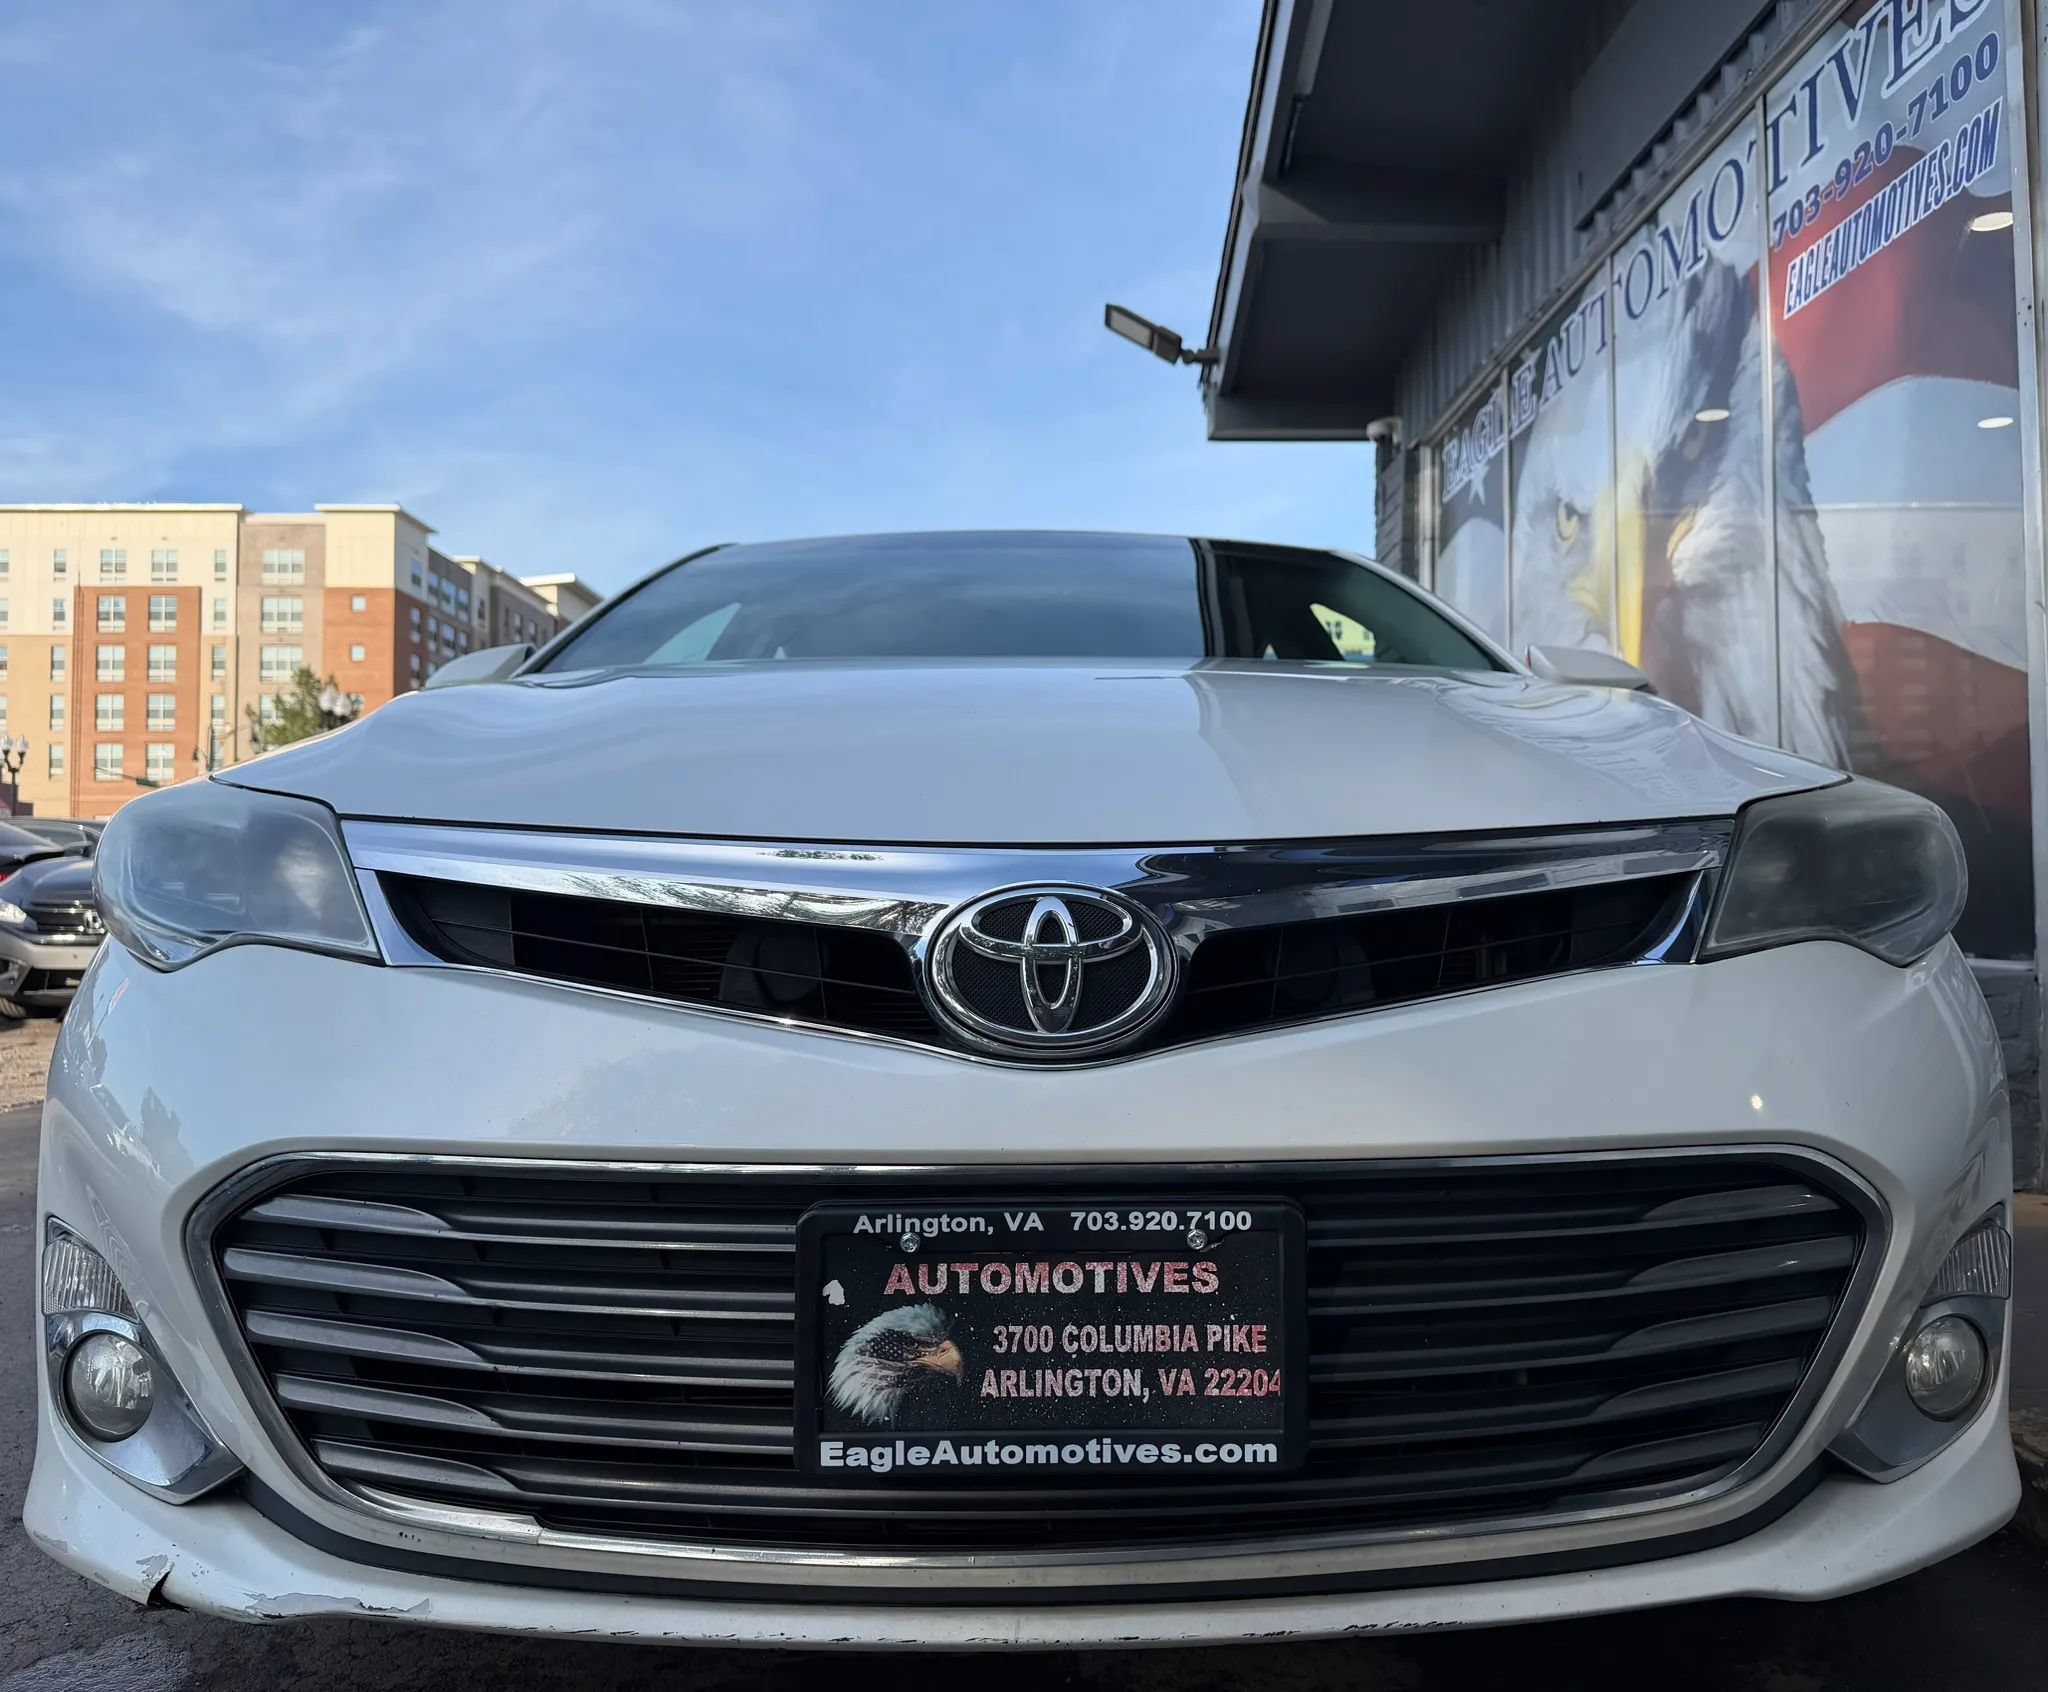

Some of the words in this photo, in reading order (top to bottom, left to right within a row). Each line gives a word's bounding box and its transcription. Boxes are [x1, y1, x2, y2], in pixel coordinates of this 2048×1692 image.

[1772, 31, 2000, 252] 703-920-7100
[1783, 97, 2003, 320] EAGLEAUTOMOTIVES.COM
[853, 1213, 994, 1236] Arlington,
[1004, 1212, 1045, 1232] VA
[1071, 1210, 1252, 1232] 703.920.7100
[883, 1260, 1221, 1296] AUTOMOTIVES
[993, 1324, 1054, 1354] 3700
[1061, 1324, 1199, 1354] COLUMBIA
[1206, 1324, 1268, 1354] PIKE
[980, 1367, 1150, 1403] ARLINGTON,
[1157, 1367, 1197, 1397] VA
[1203, 1367, 1281, 1397] 22204
[819, 1437, 1279, 1473] EagleAutomotives.com
